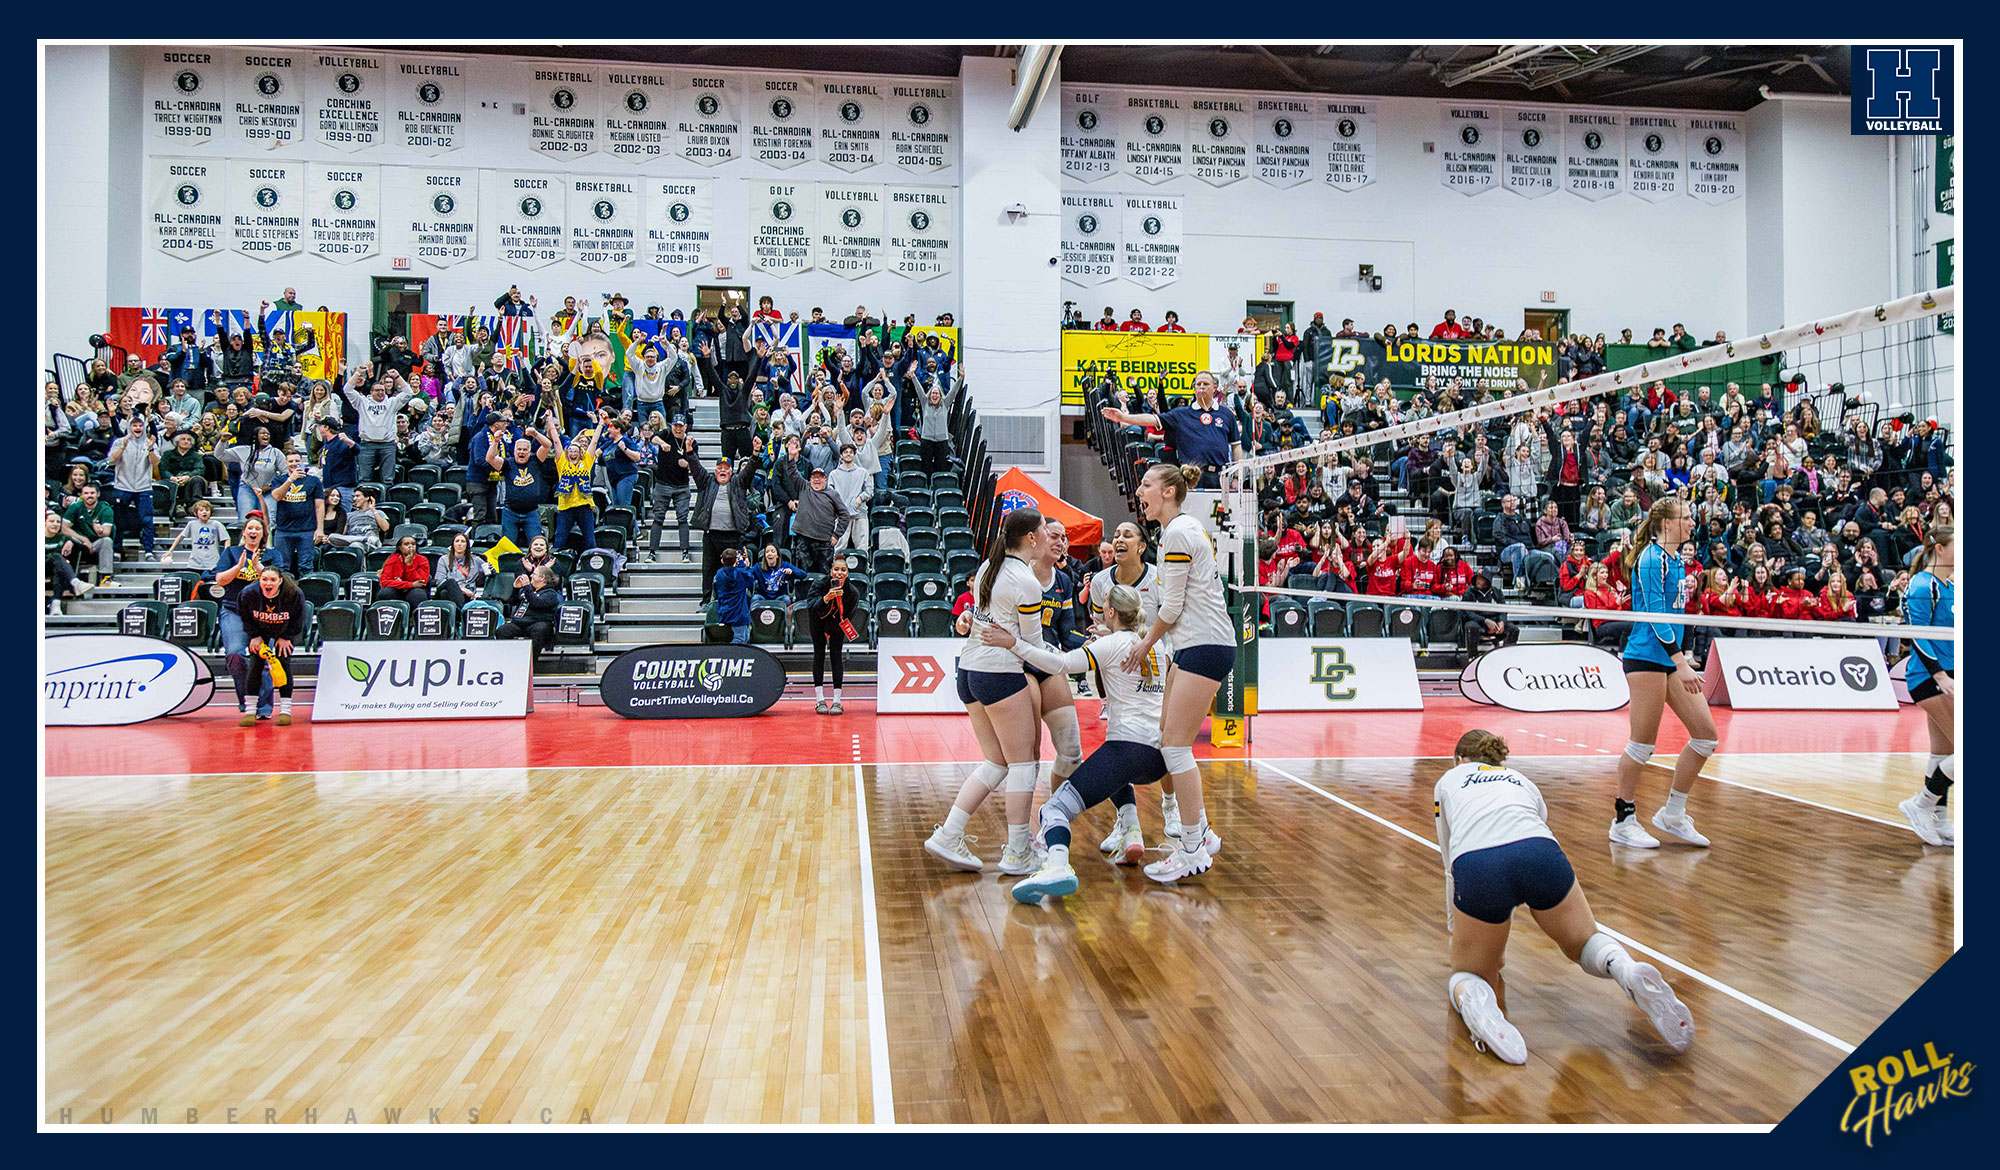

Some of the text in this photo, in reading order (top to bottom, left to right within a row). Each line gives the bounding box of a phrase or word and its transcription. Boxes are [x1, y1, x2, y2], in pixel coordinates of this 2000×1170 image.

[164, 53, 211, 64] SOCCER
[245, 56, 292, 68] SOCCER
[319, 56, 379, 69] VOLLEYBALL
[400, 64, 460, 76] VOLLEYBALL
[535, 71, 592, 82] BASKETBALL
[609, 73, 664, 86] VOLLEYBALL
[692, 78, 724, 88] SOCCER
[766, 81, 798, 91] SOCCER
[824, 84, 878, 95] VOLLEYBALL
[894, 87, 946, 98] VOLLEYBALL
[327, 98, 371, 110] COACHING
[1075, 94, 1100, 104] GOLF
[1128, 97, 1180, 109] BASKETBALL
[155, 100, 221, 112] ALL-CANADIAN
[236, 103, 300, 115] ALL-CANADIAN
[1193, 101, 1243, 112] BASKETBALL
[1258, 101, 1308, 112] BASKETBALL
[1327, 104, 1366, 114] VOLLEYBALL
[155, 113, 222, 124] TRACEY WEIGHTMAN
[319, 110, 378, 121] EXCELLENCE
[399, 111, 461, 123] ALL-CANADIAN
[1451, 110, 1489, 119] VOLLEYBALL
[1518, 112, 1546, 122] SOCCER
[1569, 115, 1616, 125] BASKETBALL
[533, 117, 594, 128] ALL-CANADIAN
[607, 120, 666, 130] ALL-CANADIAN
[1630, 117, 1677, 128] BASKETBALL
[1691, 119, 1736, 131] VOLLEYBALL
[165, 126, 211, 136] 1999-00
[679, 123, 738, 134] ALL-CANADIAN
[753, 126, 811, 136] ALL-CANADIAN
[245, 129, 291, 140] 1999-00
[326, 131, 372, 143] 1999-00
[822, 130, 880, 139] ALL-CANADIAN
[892, 132, 948, 142] ALL-CANADIAN
[408, 136, 452, 146] 2001-02
[834, 141, 868, 151] ERIN SMITH
[1061, 137, 1115, 148] ALL-CANADIAN
[540, 142, 588, 152] 2002-03
[614, 144, 660, 154] 2002-03
[686, 148, 731, 157] 2003-04
[1127, 142, 1181, 153] ALL-CANADIAN
[1192, 144, 1246, 155] ALL-CANADIAN
[1256, 144, 1310, 155] ALL-CANADIAN
[1333, 143, 1361, 153] COACHING
[760, 150, 805, 160] 2003-04
[829, 153, 874, 163] 2003-04
[1061, 149, 1115, 160] TIFFANY ALBATH
[1127, 154, 1181, 164] LINDSAY PANCHAN
[1328, 153, 1365, 163] EXCELLENCE
[1445, 151, 1496, 162] ALL-CANADIAN
[1507, 154, 1557, 165] ALL-CANADIAN
[898, 156, 942, 166] 2004-05
[1066, 161, 1110, 171] 2012-13
[1192, 157, 1245, 167] LINDSAY PANCHAN
[1256, 156, 1309, 167] LINDSAY PANCHAN
[1569, 156, 1619, 167] ALL-CANADIAN
[1630, 159, 1678, 169] ALL-CANADIAN
[1691, 161, 1739, 172] ALL-CANADIAN
[170, 166, 207, 177] SOCCER
[249, 168, 286, 180] SOCCER
[327, 171, 362, 182] SOCCER
[426, 176, 461, 186] SOCCER
[514, 179, 548, 189] SOCCER
[576, 182, 632, 193] BASKETBALL
[663, 185, 696, 195] SOCCER
[770, 186, 795, 195] GOLF
[825, 190, 879, 201] VOLLEYBALL
[894, 193, 947, 204] BASKETBALL
[1062, 196, 1114, 208] VOLLEYBALL
[1126, 198, 1178, 210] VOLLEYBALL
[155, 214, 221, 225] ALL-CANADIAN
[235, 216, 299, 226] ALL-CANADIAN
[312, 218, 376, 229] ALL-CANADIAN
[159, 226, 216, 237] KARA CAMPBELL
[412, 222, 473, 233] ALL-CANADIAN
[500, 225, 561, 235] ALL-CANADIAN
[574, 228, 634, 238] ALL-CANADIAN
[760, 226, 804, 236] COACHING
[235, 228, 299, 239] NICOLE STEPHENS
[649, 230, 709, 241] ALL-CANADIAN
[162, 239, 213, 249] 2004-05
[242, 240, 292, 251] 2005-06
[753, 236, 810, 246] EXCELLENCE
[823, 236, 880, 246] ALL-CANADIAN
[892, 238, 948, 248] ALL-CANADIAN
[1061, 241, 1115, 251] ALL-CANADIAN
[319, 243, 369, 254] 2006-07
[419, 246, 466, 257] 2006-07
[658, 243, 700, 252] KATIE WATTS
[1126, 243, 1180, 254] ALL-CANADIAN
[507, 250, 555, 260] 2007-08
[580, 252, 627, 262] 2007-08
[656, 255, 699, 264] 2009-10
[393, 258, 407, 267] EXIT
[761, 258, 803, 267] 2010-11
[830, 260, 872, 270] 2010-11
[899, 262, 941, 272] 2010-11
[717, 267, 730, 277] EXIT
[1065, 265, 1110, 274] 2019-20
[1130, 266, 1174, 276] 2021-22
[1266, 283, 1278, 292] EXIT
[1544, 292, 1555, 300] EXIT
[1387, 343, 1552, 365] LORDS NATION
[1077, 360, 1196, 374] KATE BEIRNESS
[1421, 365, 1518, 377] BRING THE NOISE
[346, 649, 504, 696] yupi.ca
[632, 658, 754, 681] COURT TIME
[1503, 665, 1607, 691] Canada
[1736, 666, 1836, 686] Ontario
[633, 680, 695, 690] VOLLEYBALL
[389, 702, 415, 710] Buying
[433, 701, 458, 709] Selling
[630, 694, 753, 707] CourtTimeVolleyball.Ca
[1461, 772, 1523, 788] Hawks
